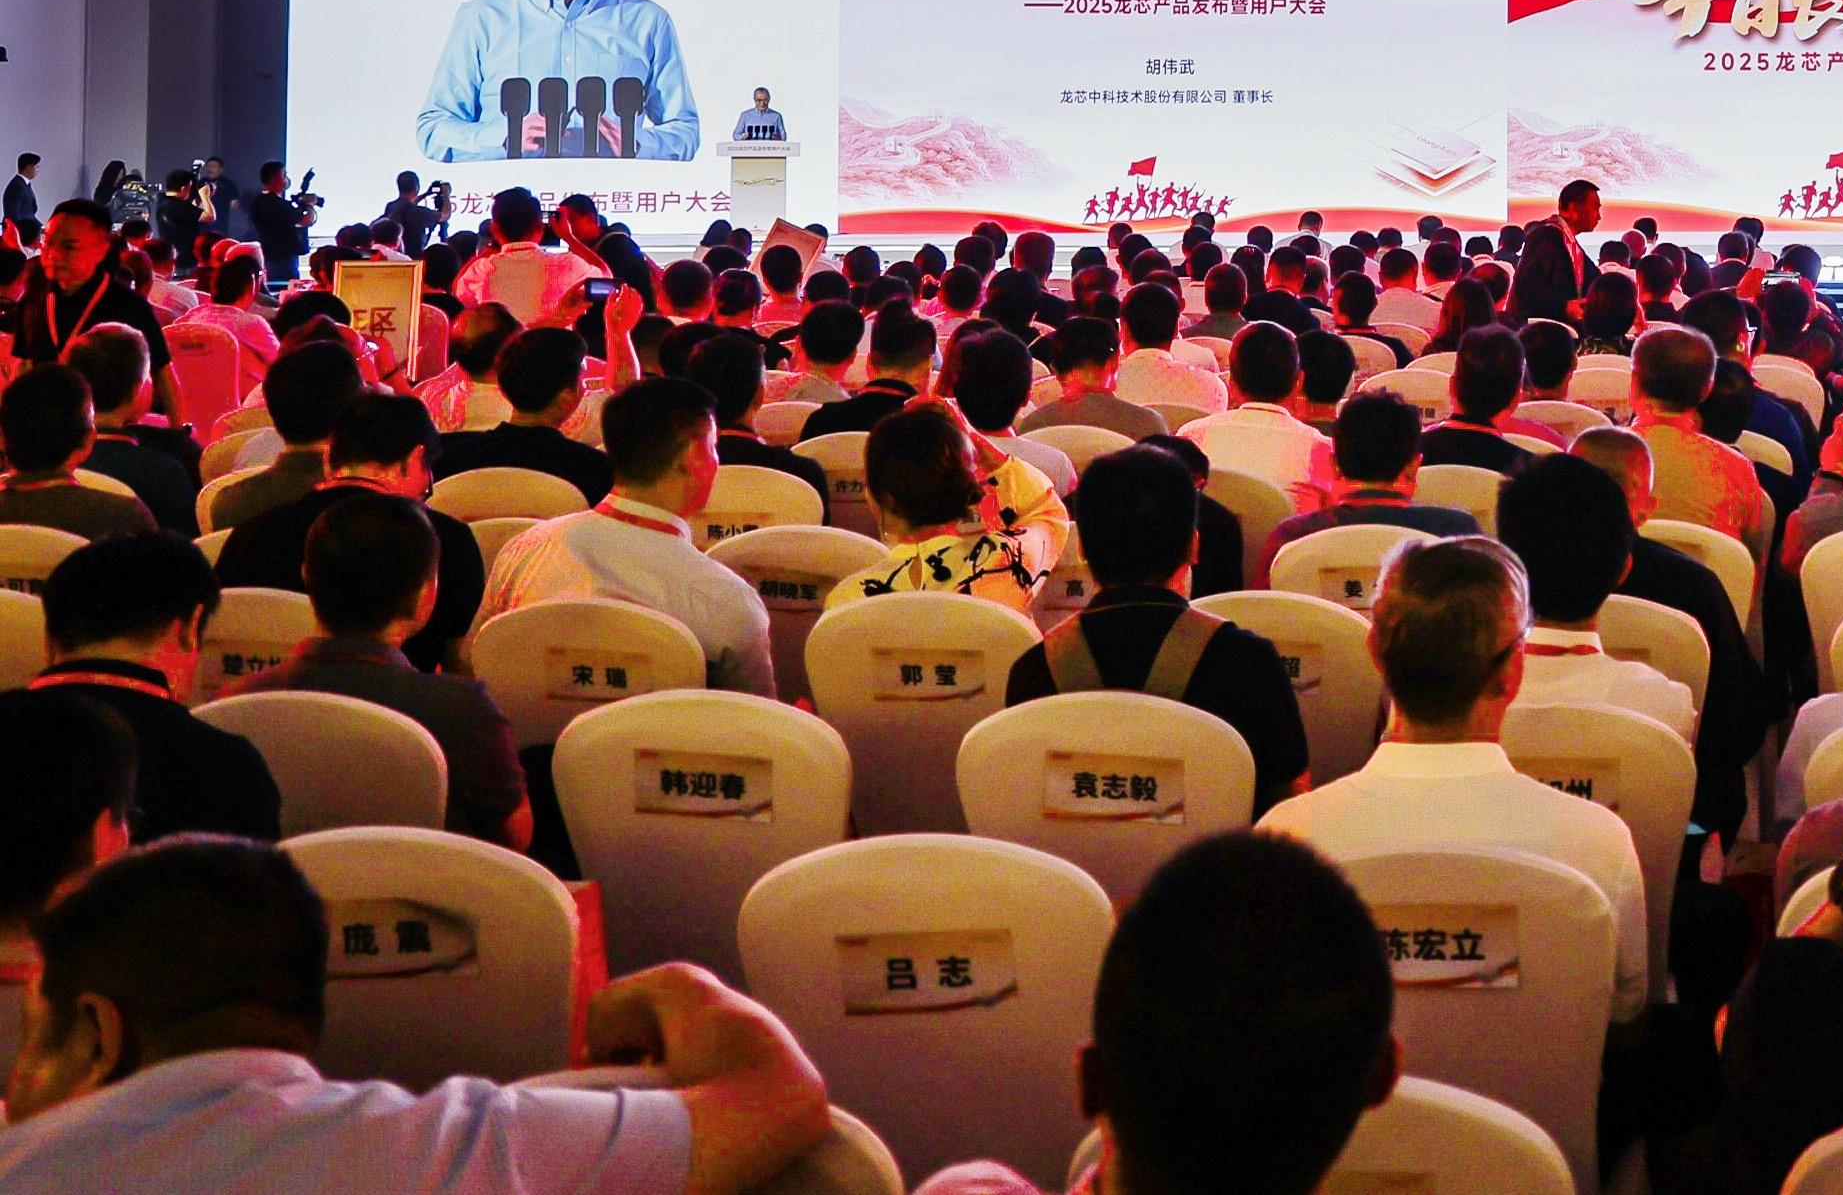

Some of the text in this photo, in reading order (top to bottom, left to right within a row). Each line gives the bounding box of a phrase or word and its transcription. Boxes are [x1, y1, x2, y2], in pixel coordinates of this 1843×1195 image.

[1145, 58, 1196, 76] 胡伟武
[1060, 89, 1273, 104] 龙芯中科技术股份有限公司 董事长
[660, 769, 746, 800] 韩迎春
[1072, 771, 1158, 802] 袁志毅
